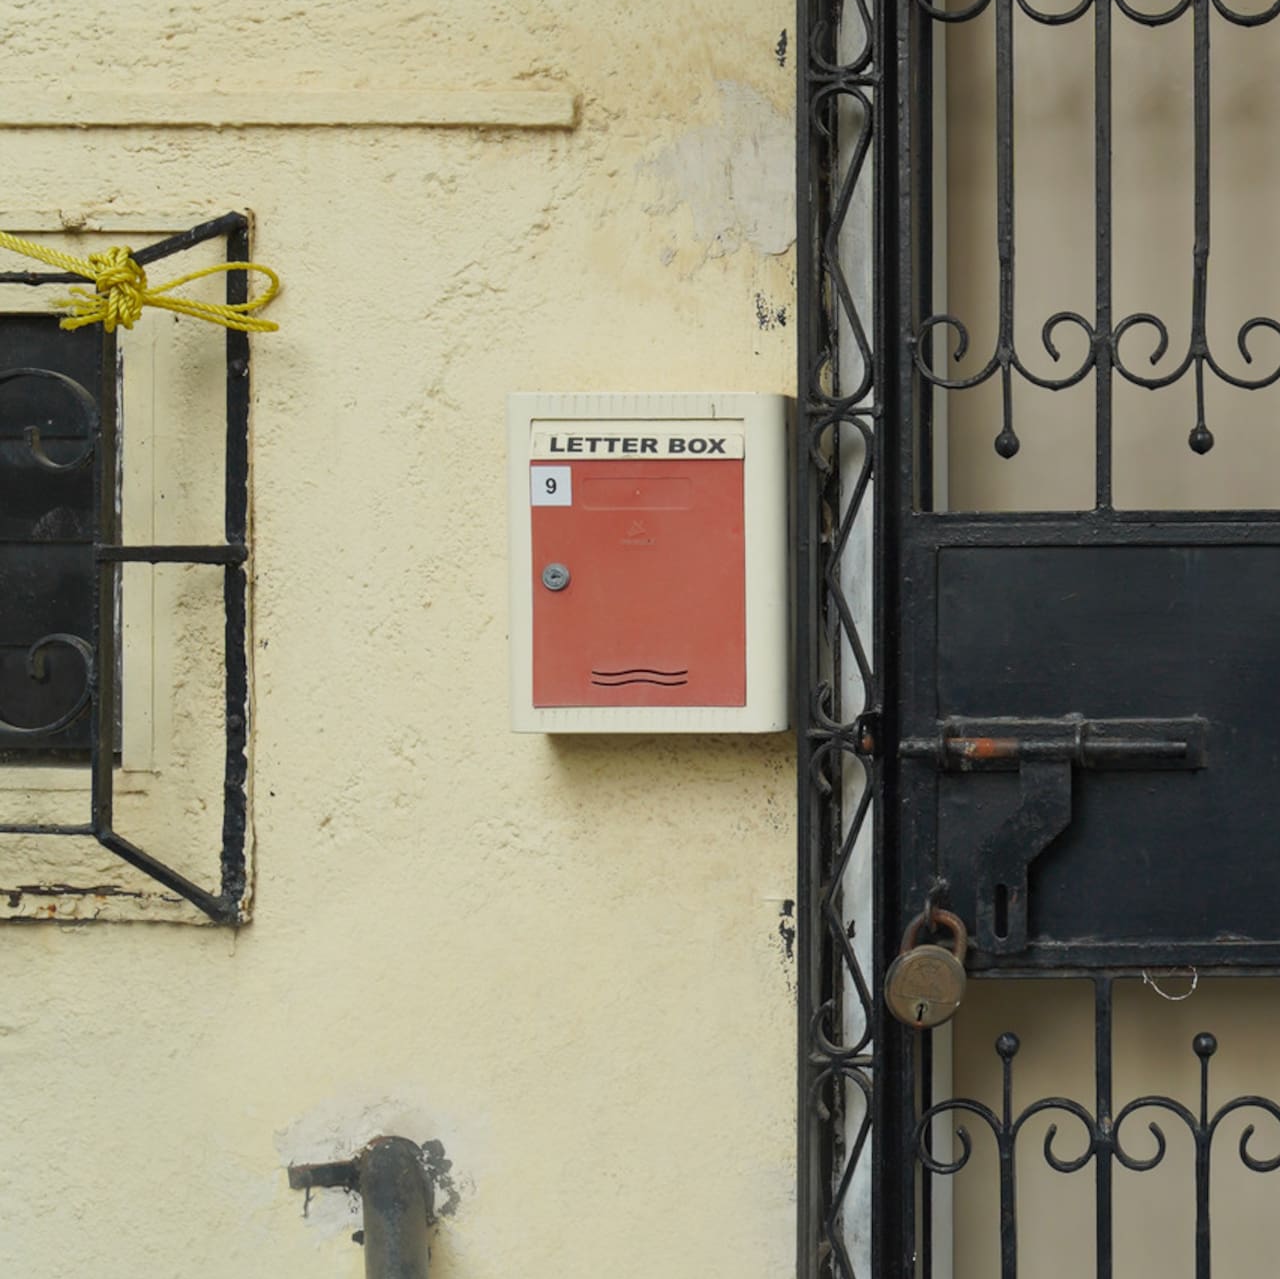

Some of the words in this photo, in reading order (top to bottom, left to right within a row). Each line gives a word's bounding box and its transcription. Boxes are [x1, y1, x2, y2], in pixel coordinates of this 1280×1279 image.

[549, 437, 658, 453] LETTER
[668, 438, 727, 454] BOX
[545, 477, 557, 495] 9
